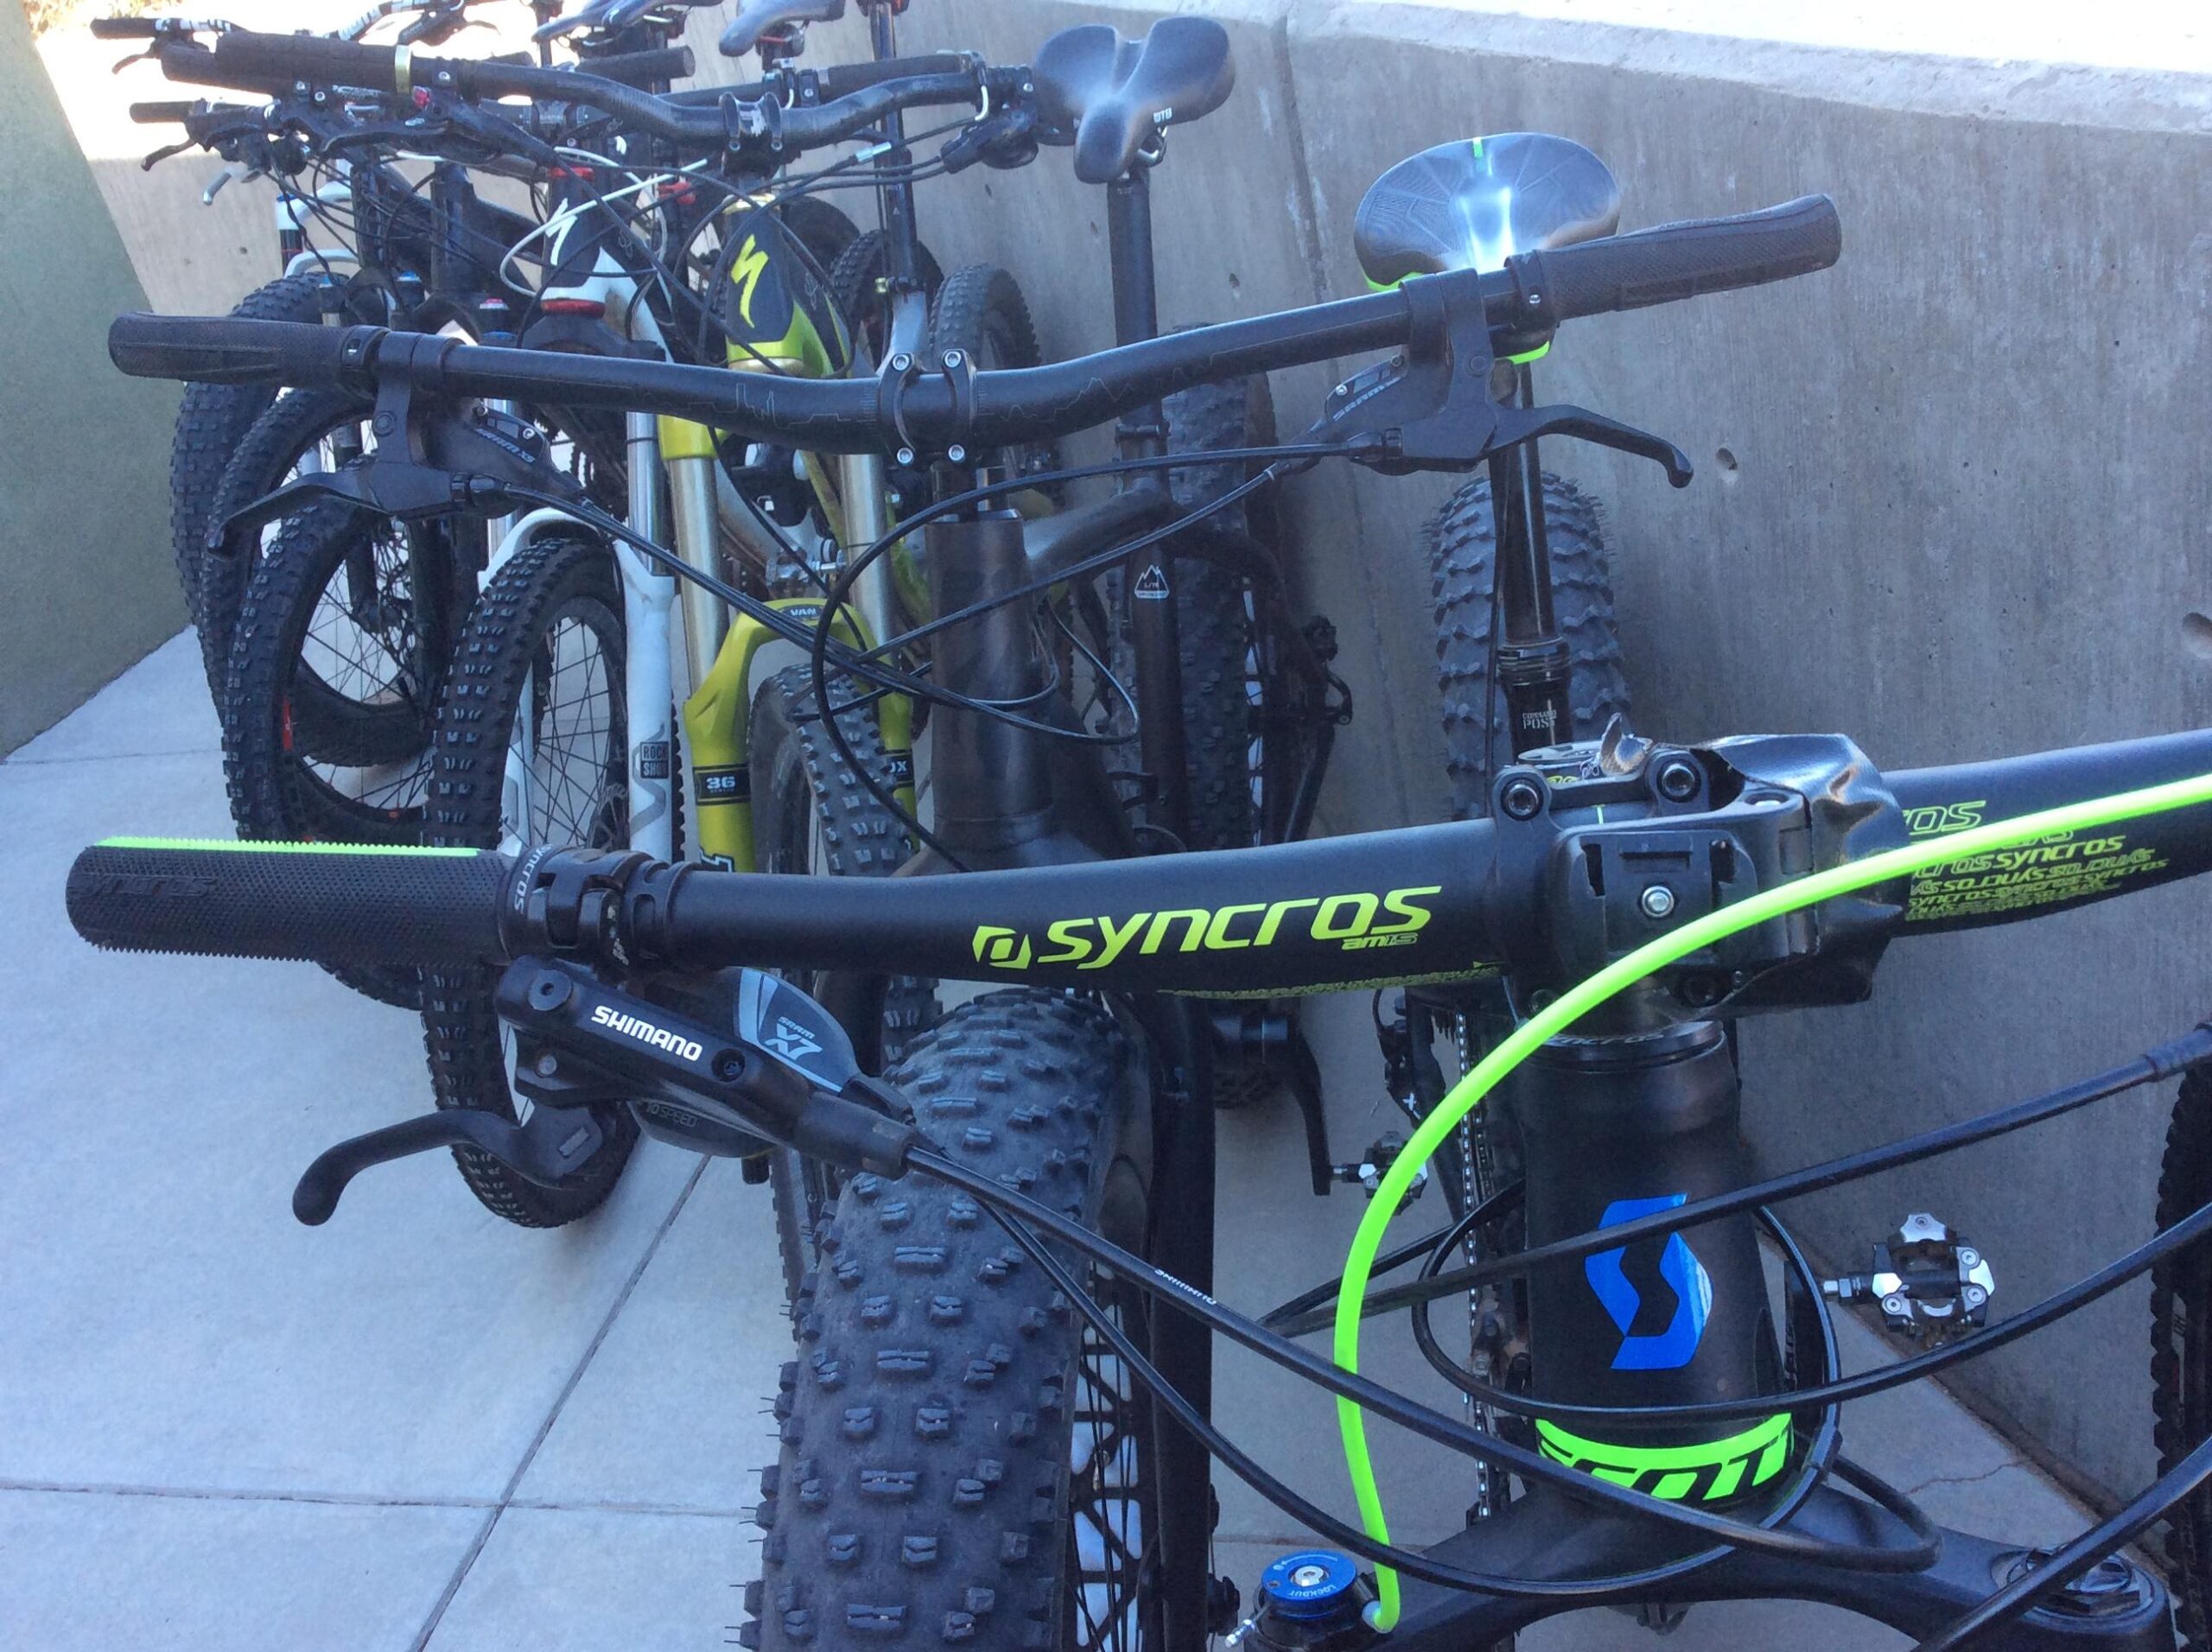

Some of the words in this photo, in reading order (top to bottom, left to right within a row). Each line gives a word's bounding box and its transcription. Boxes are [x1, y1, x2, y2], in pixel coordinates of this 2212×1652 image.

[1154, 108, 1173, 123] WTB
[707, 777, 736, 790] 36
[1037, 885, 1442, 970] syncros
[591, 1005, 702, 1061] SHIMANO
[778, 1016, 815, 1039] SRAM
[1288, 1584, 1337, 1598] LOCKOUT
